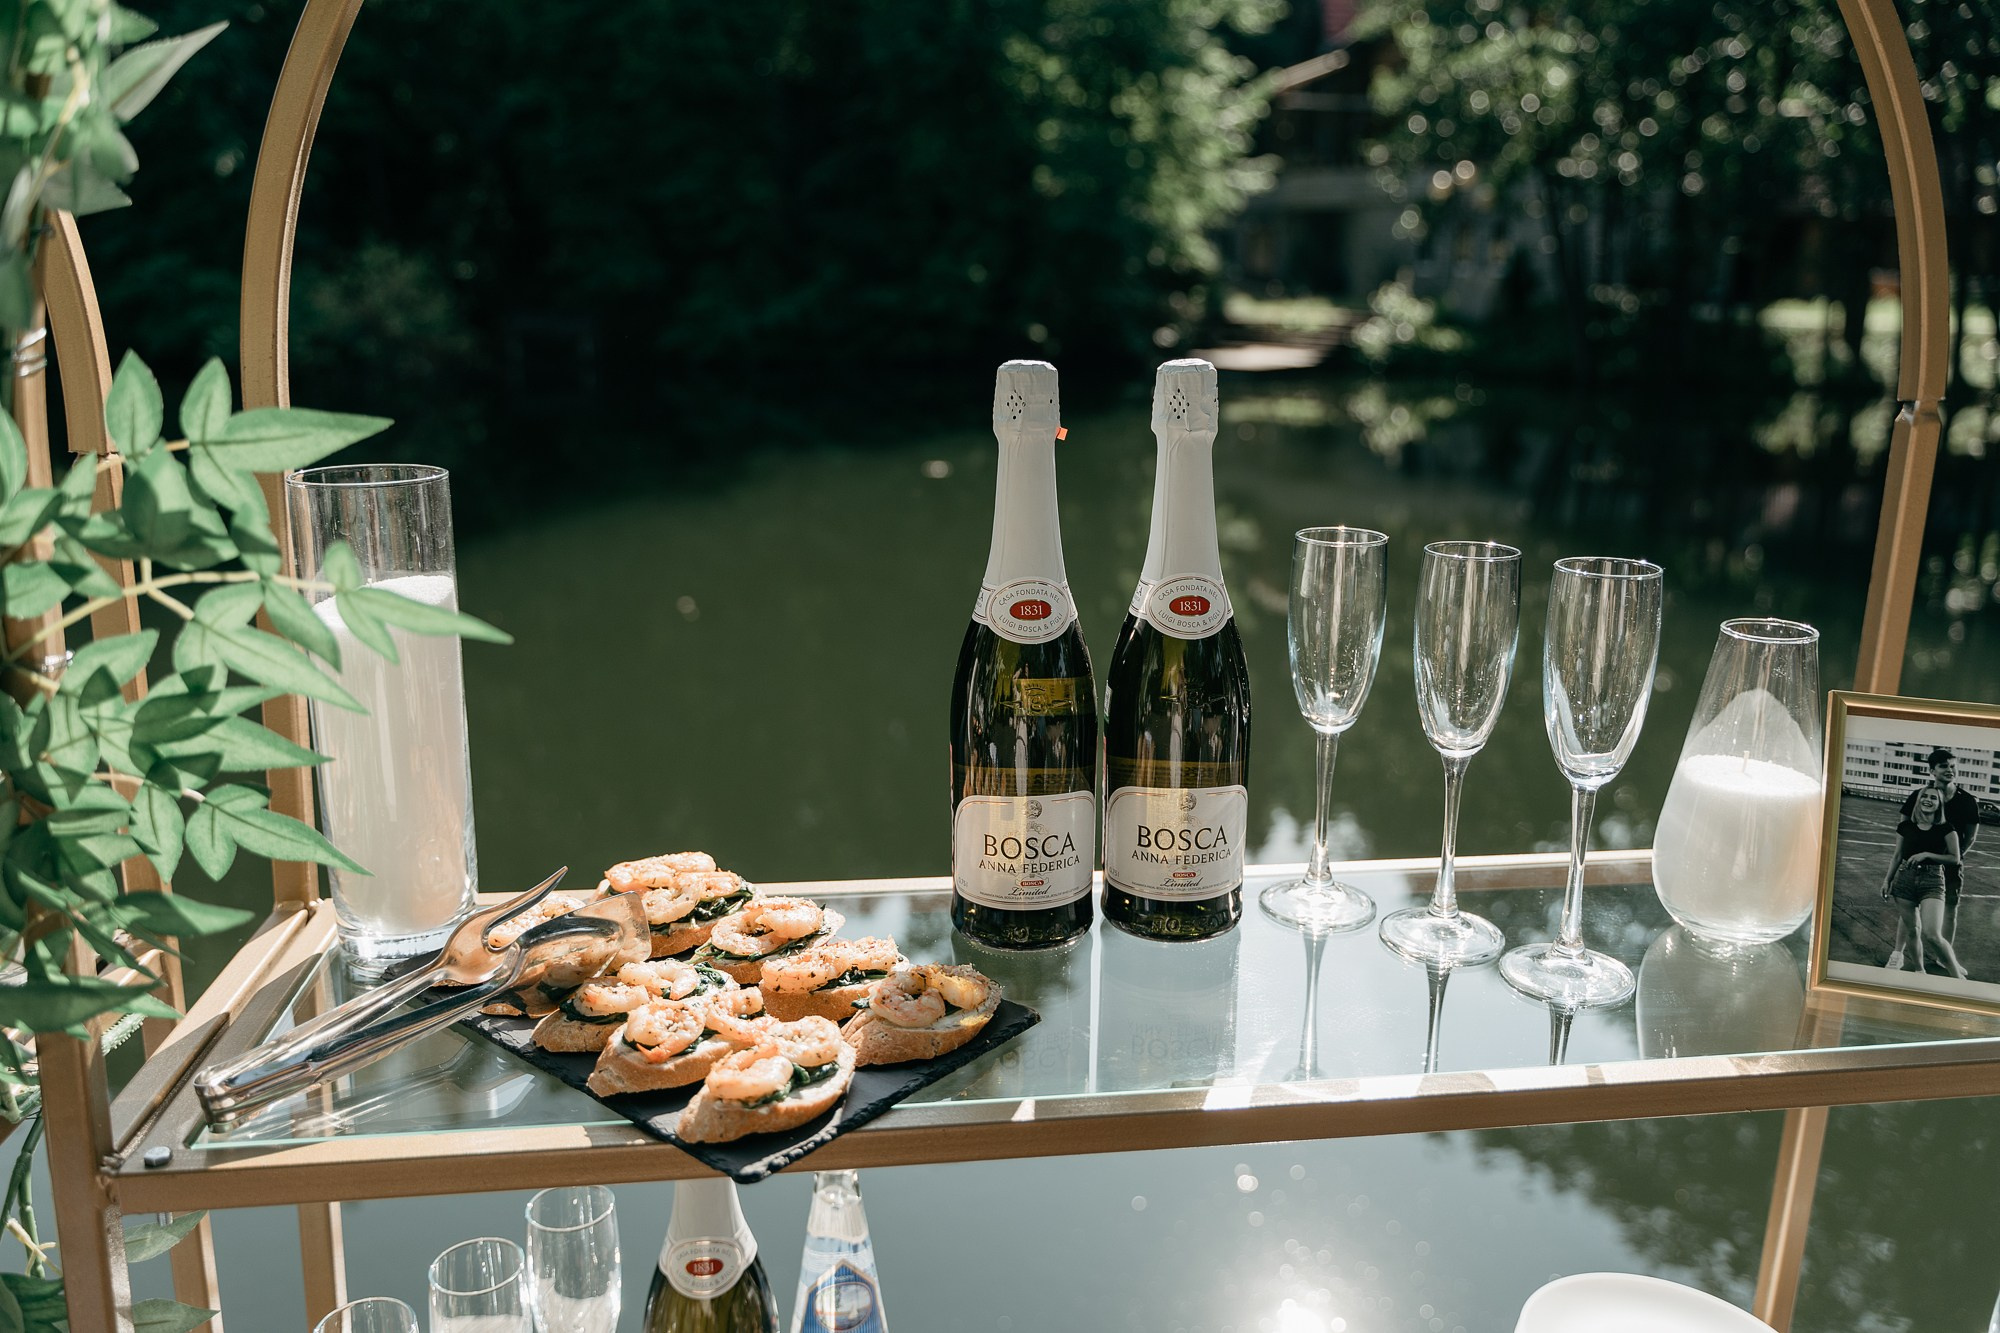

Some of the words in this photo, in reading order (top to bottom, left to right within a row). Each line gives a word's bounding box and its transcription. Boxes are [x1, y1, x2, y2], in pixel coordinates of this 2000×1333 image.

[998, 593, 1015, 606] CASA
[1016, 588, 1049, 597] FONDATA
[1050, 592, 1060, 603] NEL
[1158, 588, 1175, 601] CASA
[1176, 584, 1208, 593] FONDATA
[1209, 588, 1219, 600] NEL
[1020, 605, 1042, 616] 1831
[1180, 601, 1201, 611] 1831
[998, 615, 1016, 629] LUIGI
[1018, 624, 1042, 632] BOSCA
[1050, 613, 1063, 627] FIGLI
[1158, 610, 1176, 623] LUIGI
[1177, 620, 1201, 628] BOSCA
[1209, 610, 1221, 623] FIGLI
[984, 832, 1076, 860] BOSCA
[1137, 825, 1228, 851] BOSCA
[979, 859, 1016, 873] ANNA
[1023, 855, 1080, 873] FEDERICA
[1131, 850, 1169, 864] ANNA
[1175, 848, 1231, 865] FEDERICA
[1008, 885, 1051, 896] Limited
[1160, 877, 1203, 888] Limited
[694, 1261, 714, 1273] 1831
